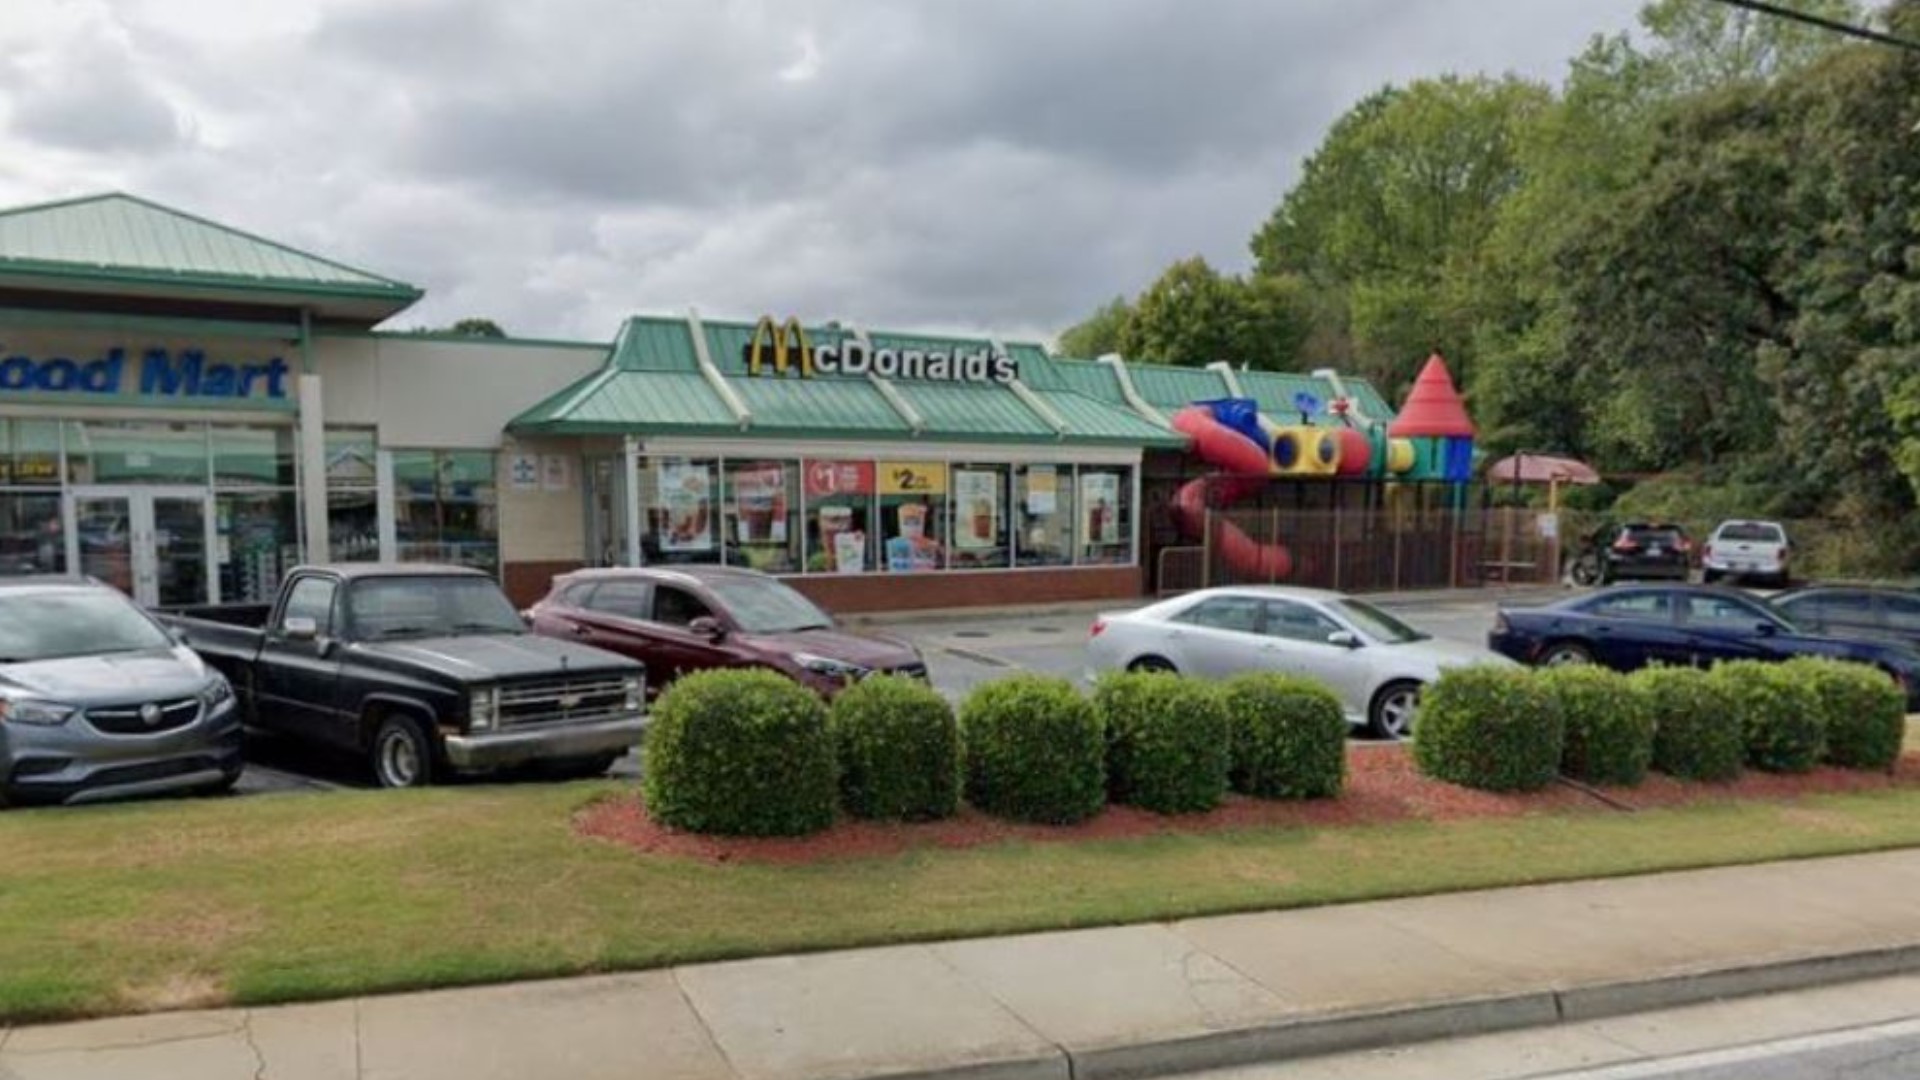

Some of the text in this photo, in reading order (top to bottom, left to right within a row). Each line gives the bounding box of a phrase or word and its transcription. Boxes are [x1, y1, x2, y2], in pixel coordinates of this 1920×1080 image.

[0, 347, 288, 397] ood Mart
[748, 315, 1018, 383] McDonald's
